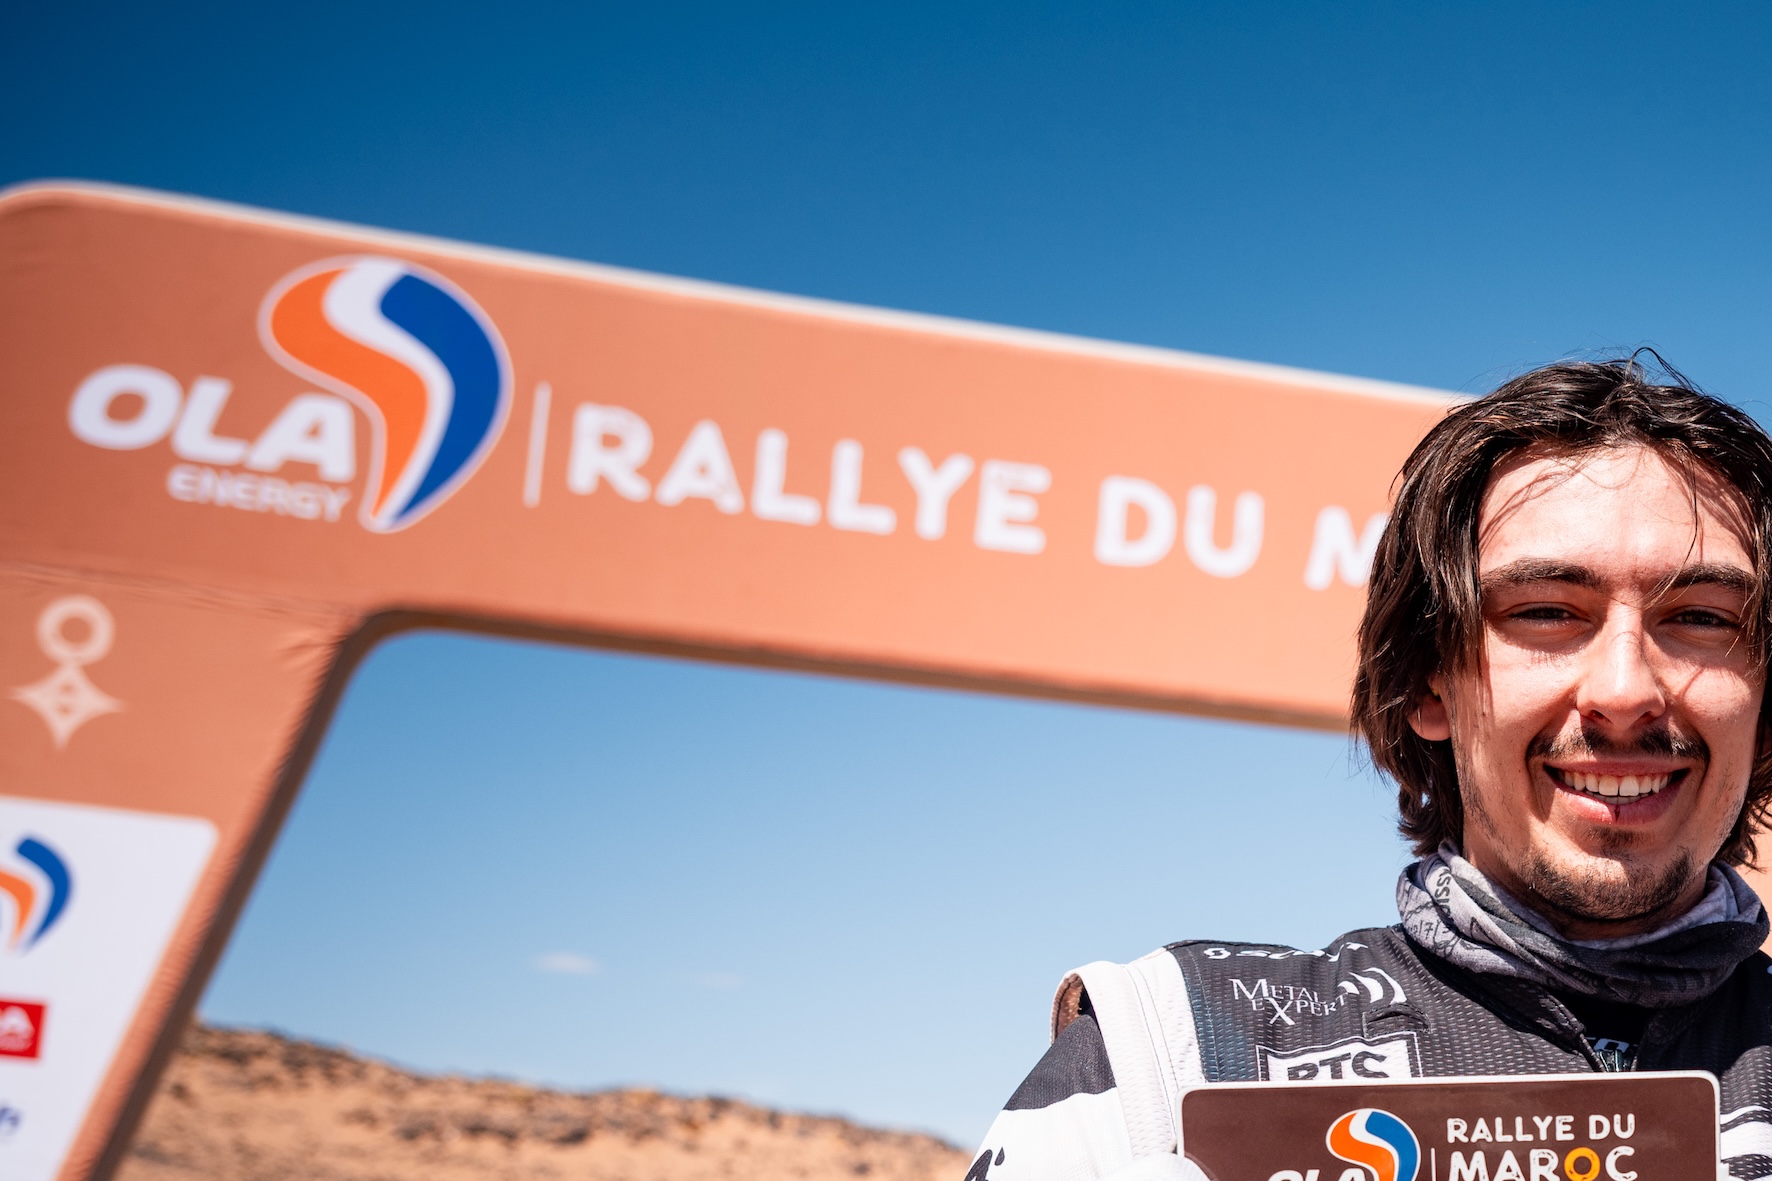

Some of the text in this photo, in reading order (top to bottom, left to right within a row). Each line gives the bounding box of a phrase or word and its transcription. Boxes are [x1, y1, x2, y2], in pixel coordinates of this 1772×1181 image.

[68, 364, 357, 482] OLA
[567, 402, 1053, 556] RALLYE
[1094, 476, 1264, 578] DU
[166, 464, 350, 520] ENERGY
[1229, 978, 1327, 1001] METAL
[1252, 992, 1349, 1026] EXPERT
[1447, 1114, 1636, 1144] RALLYE DU
